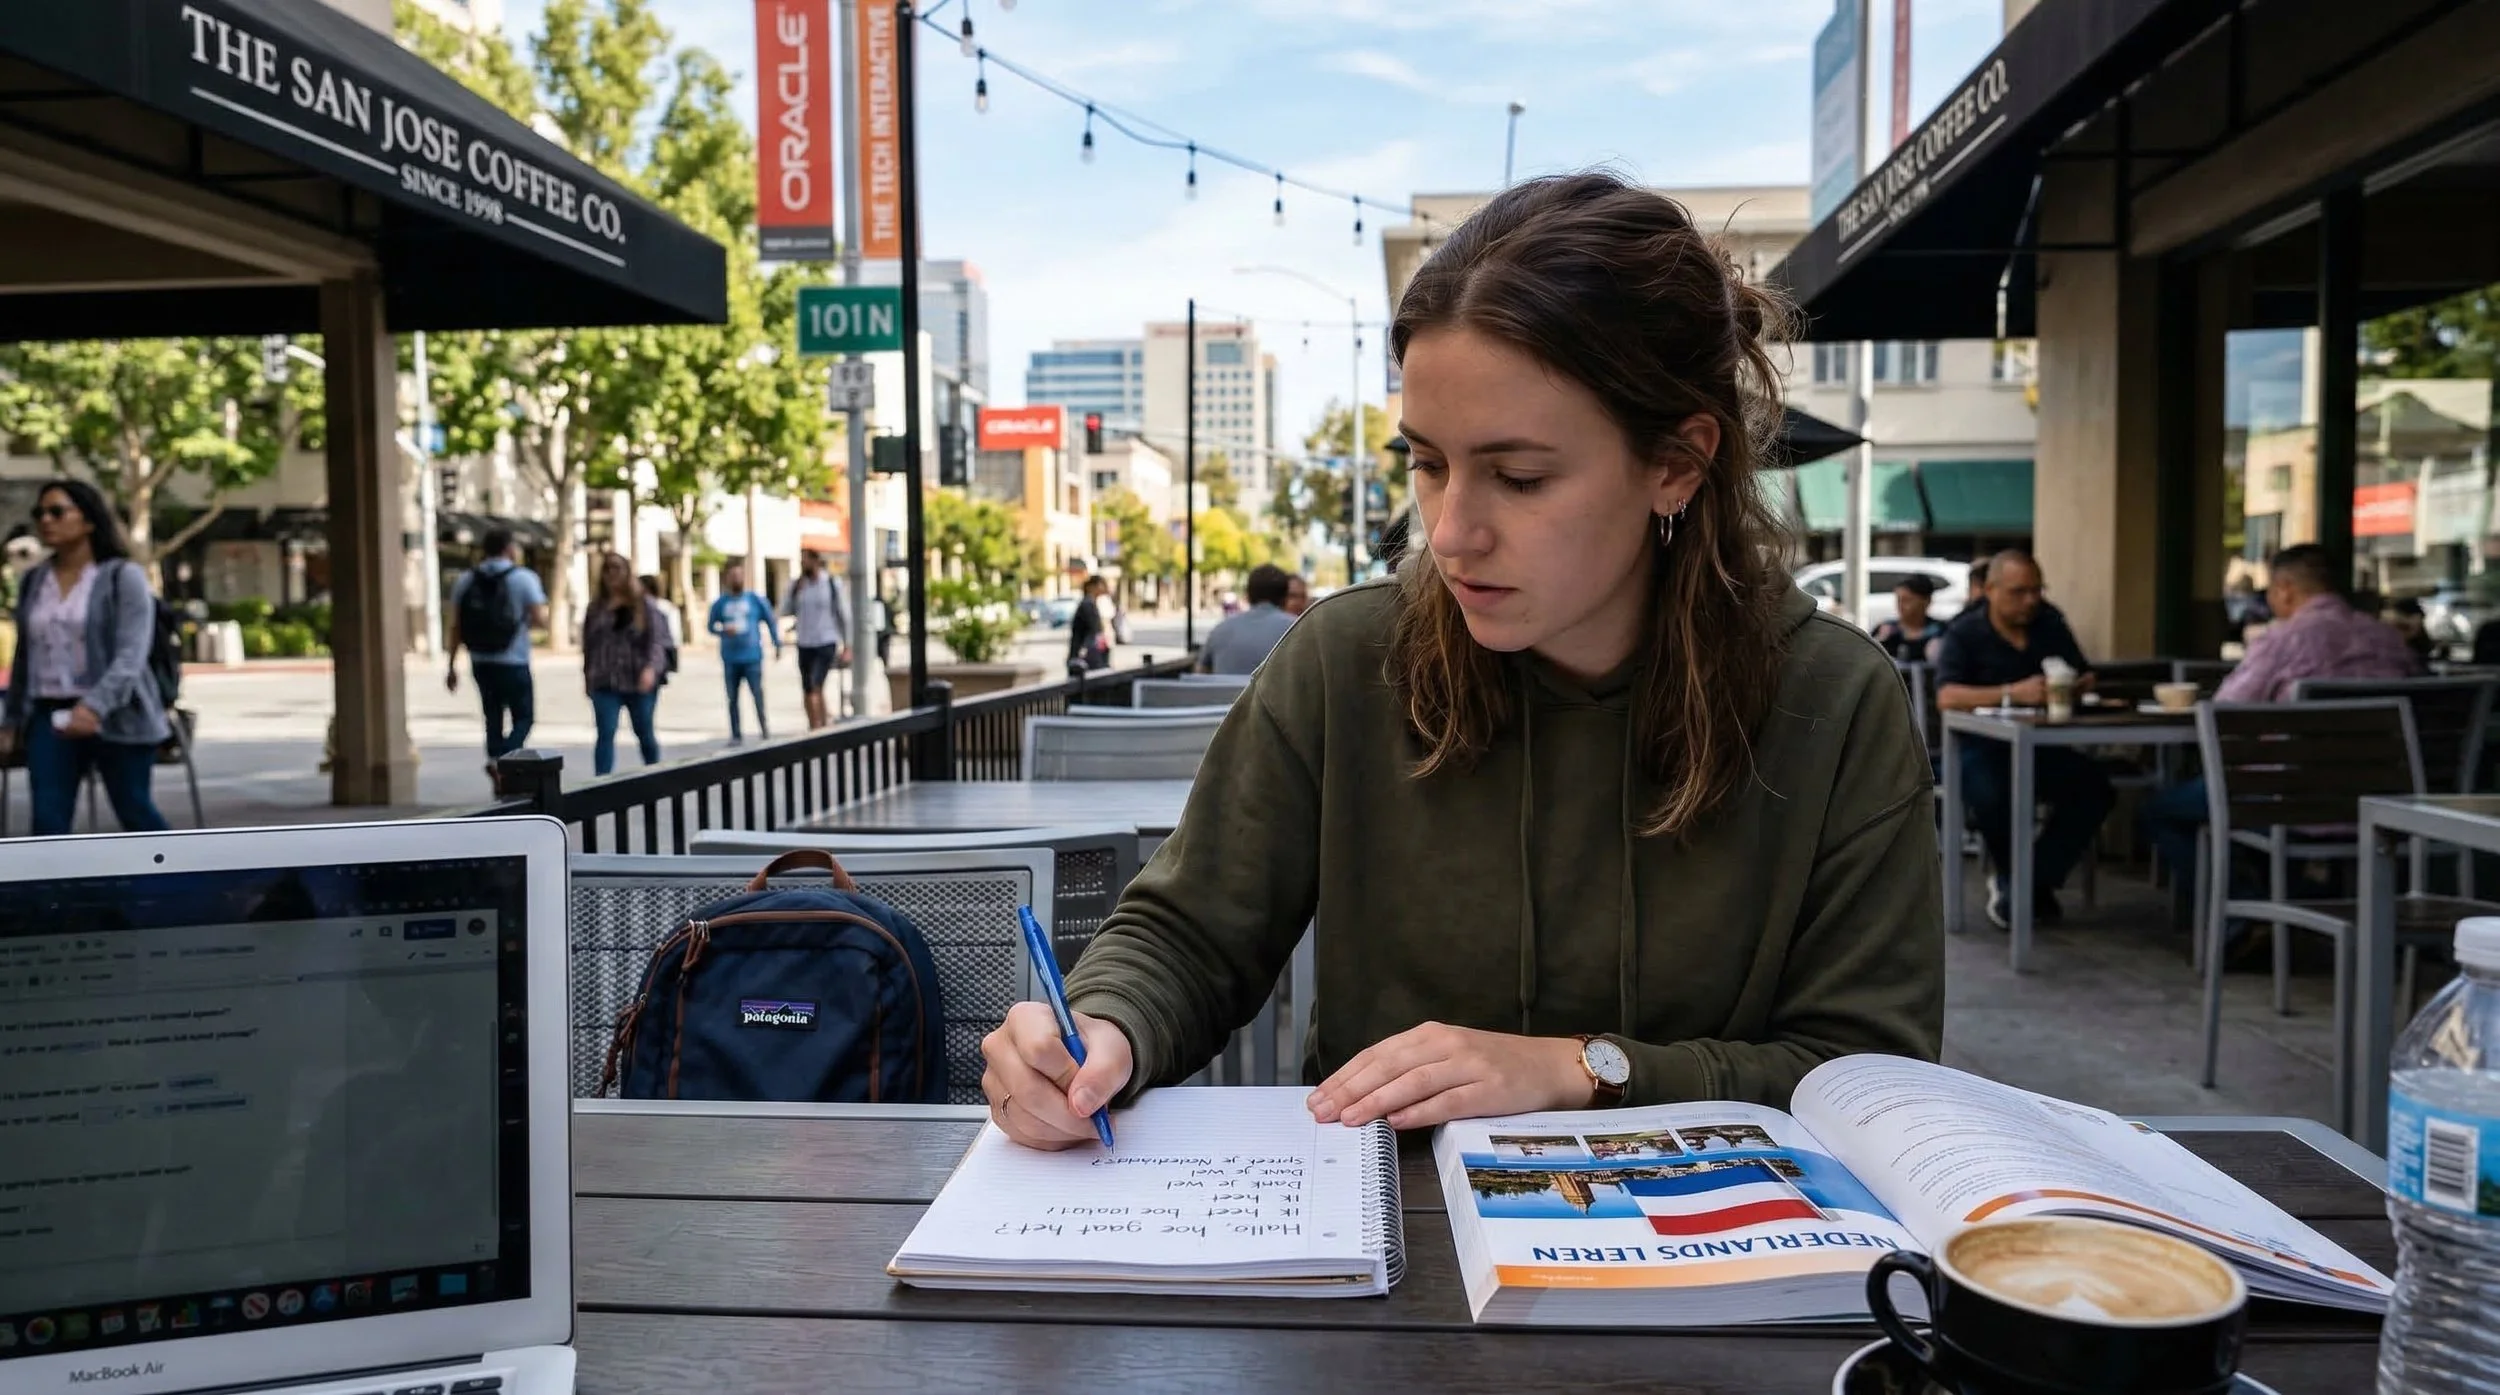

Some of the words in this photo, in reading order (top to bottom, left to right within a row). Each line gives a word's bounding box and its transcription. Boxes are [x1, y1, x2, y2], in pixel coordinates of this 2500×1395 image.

[868, 4, 891, 137] INTERACTIVE
[777, 13, 811, 212] ORACLE
[182, 7, 280, 95] THE
[291, 57, 371, 134] SAN
[381, 98, 462, 173] JOSE
[468, 140, 578, 224] COFFEE
[582, 192, 627, 244] CO.
[1836, 197, 1860, 243] THE
[1915, 84, 1978, 171] COFFEE
[1977, 58, 2011, 114] CO.
[871, 142, 893, 195] TECH
[401, 163, 462, 210] SINCE
[464, 188, 504, 226] 1998
[872, 202, 895, 241] THE
[984, 418, 1056, 435] ORACLE
[743, 1010, 808, 1025] patagonia
[1221, 1156, 1240, 1164] je
[1236, 1165, 1254, 1175] je
[1219, 1179, 1240, 1188] je
[1203, 1206, 1259, 1219] heet
[994, 1222, 1063, 1236] het?
[1076, 1220, 1143, 1236] gaat
[1160, 1224, 1206, 1238] hoe
[1225, 1222, 1301, 1237] Hallo,
[1534, 1246, 1647, 1262] LEREN
[1657, 1231, 1902, 1261] NEDERLANDS
[68, 1363, 140, 1383] MacBook
[143, 1360, 167, 1375] Air
